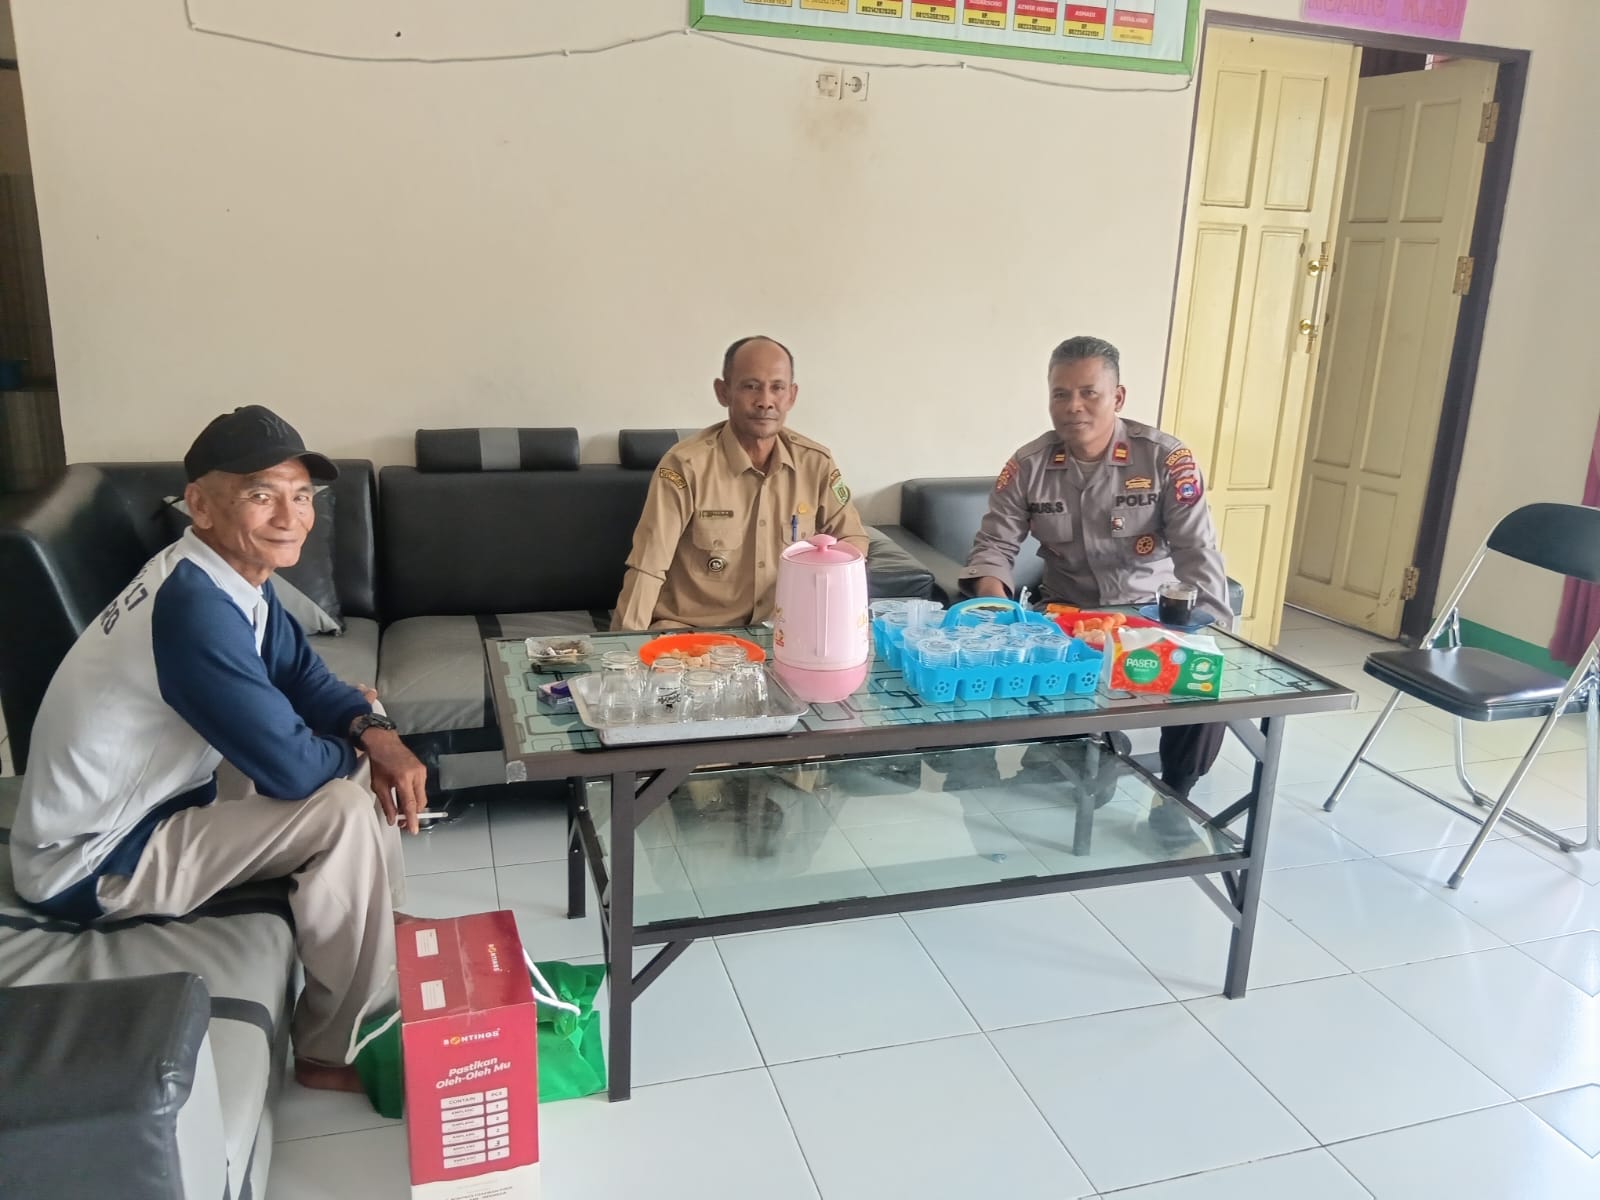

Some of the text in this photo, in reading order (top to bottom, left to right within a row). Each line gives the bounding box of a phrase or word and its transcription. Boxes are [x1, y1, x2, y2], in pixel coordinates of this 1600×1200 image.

[435, 1061, 511, 1089] Oleh-Oleh Mu
[448, 1057, 498, 1077] Pastikan
